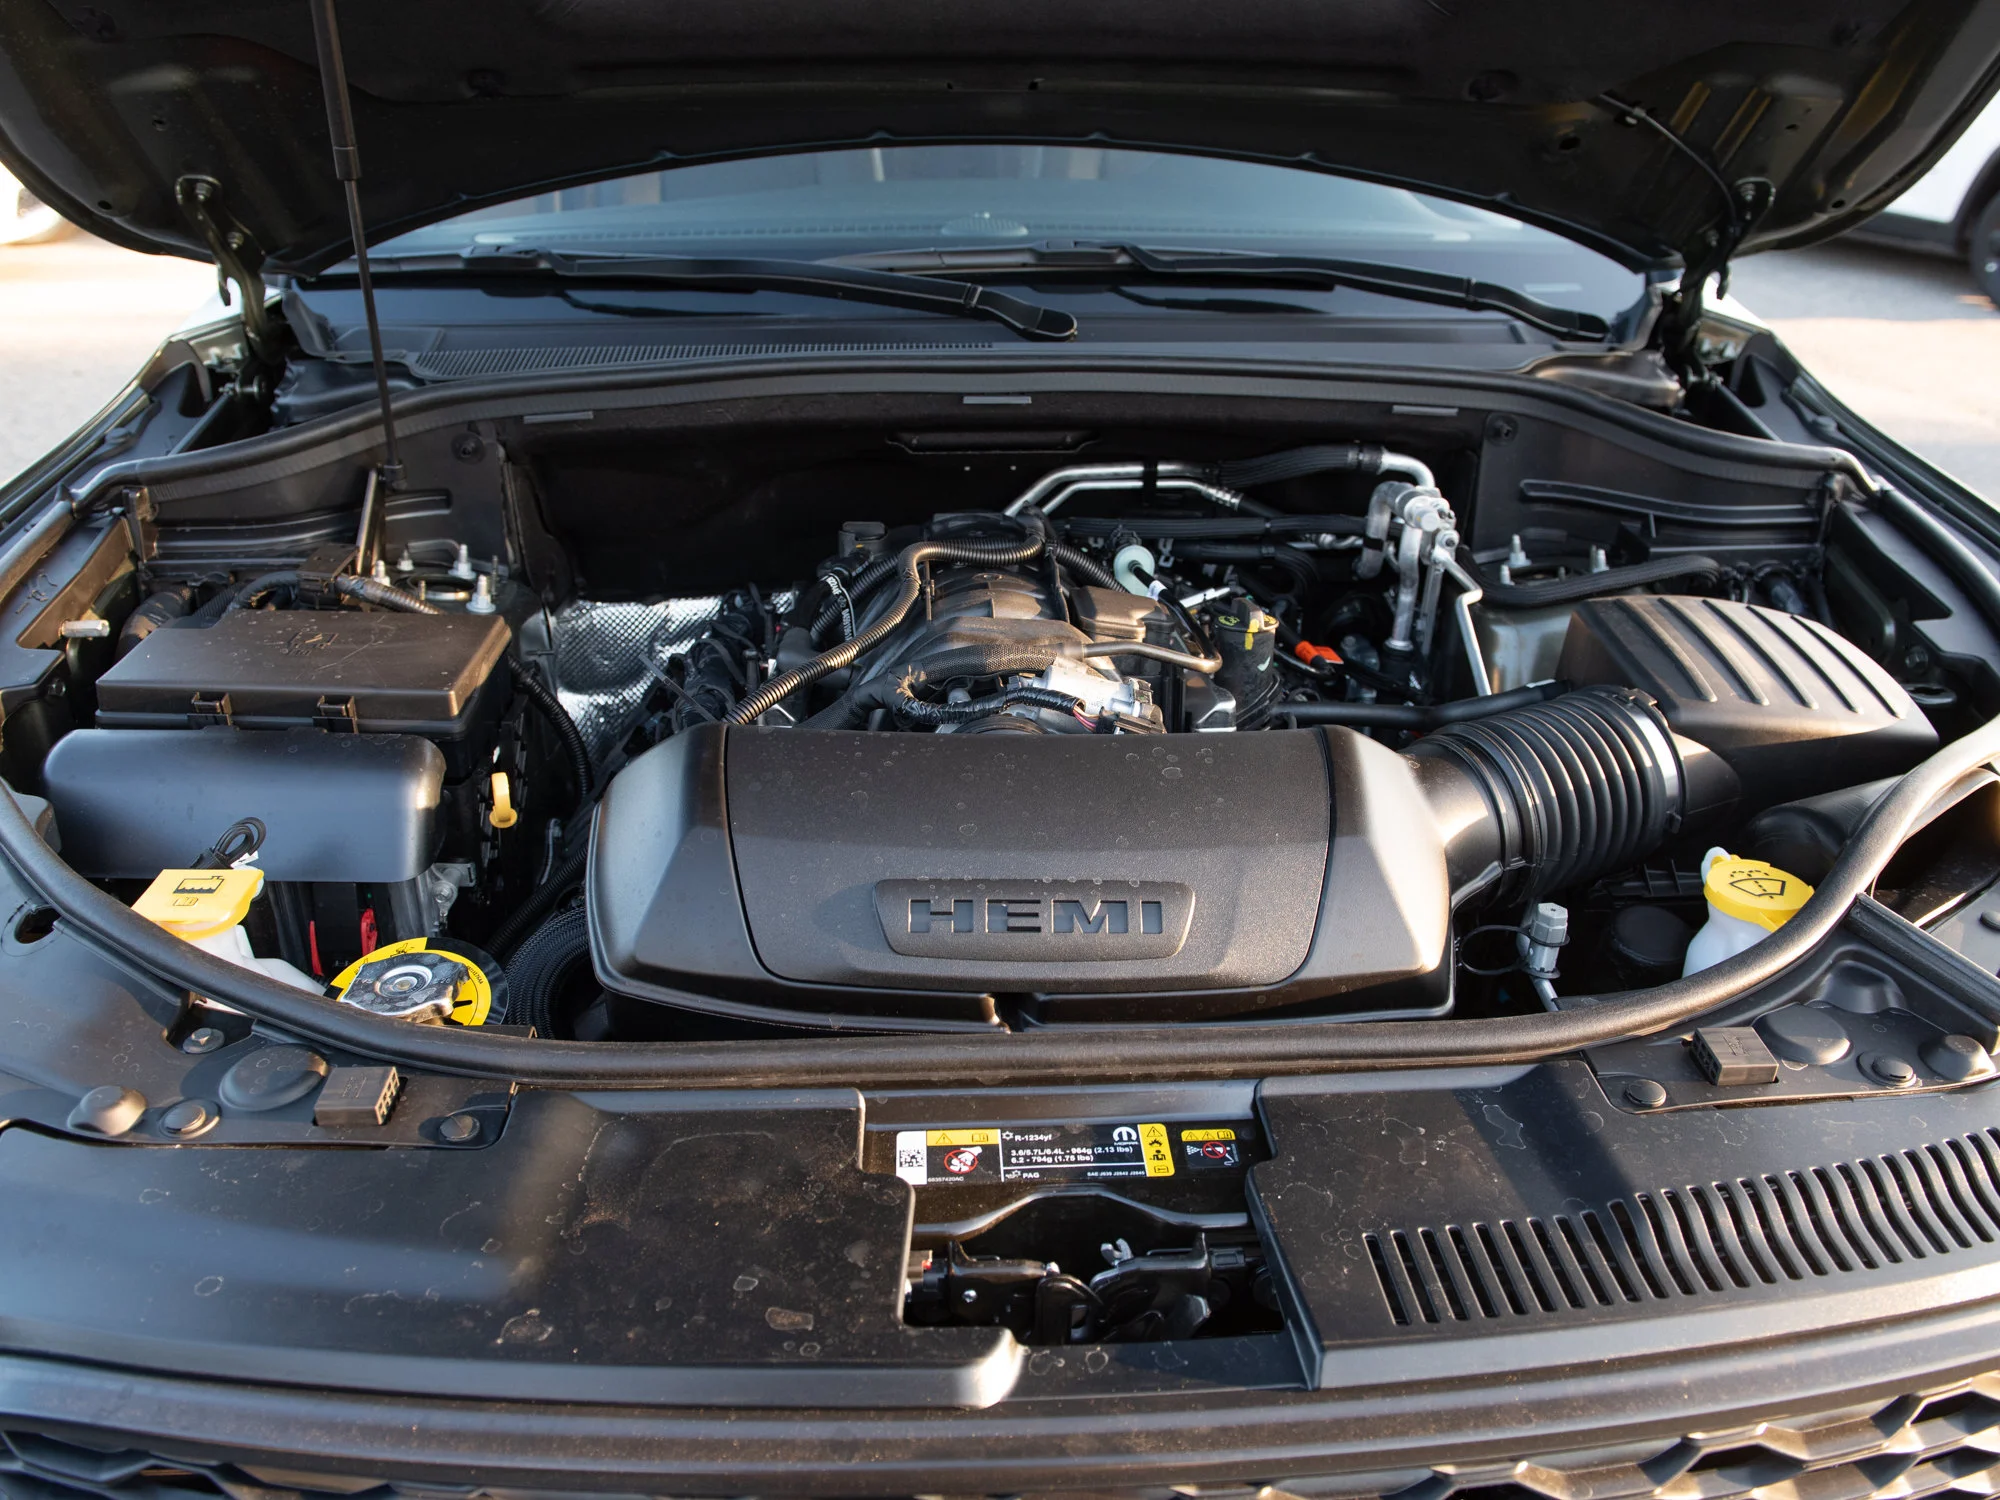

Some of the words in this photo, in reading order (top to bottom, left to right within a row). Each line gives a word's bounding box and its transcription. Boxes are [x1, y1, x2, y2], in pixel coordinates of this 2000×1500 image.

[907, 898, 1164, 935] HEMI
[1015, 1133, 1052, 1142] R-1234yf
[1011, 1148, 1064, 1157] 3.6/5.7L/6.4L
[1094, 1146, 1115, 1155] (2.13
[1117, 1146, 1133, 1154] lbs)
[1011, 1156, 1024, 1164] 6.2
[1032, 1156, 1052, 1164] 794g
[1054, 1155, 1075, 1163] (1.75
[1077, 1154, 1094, 1162] lbs)
